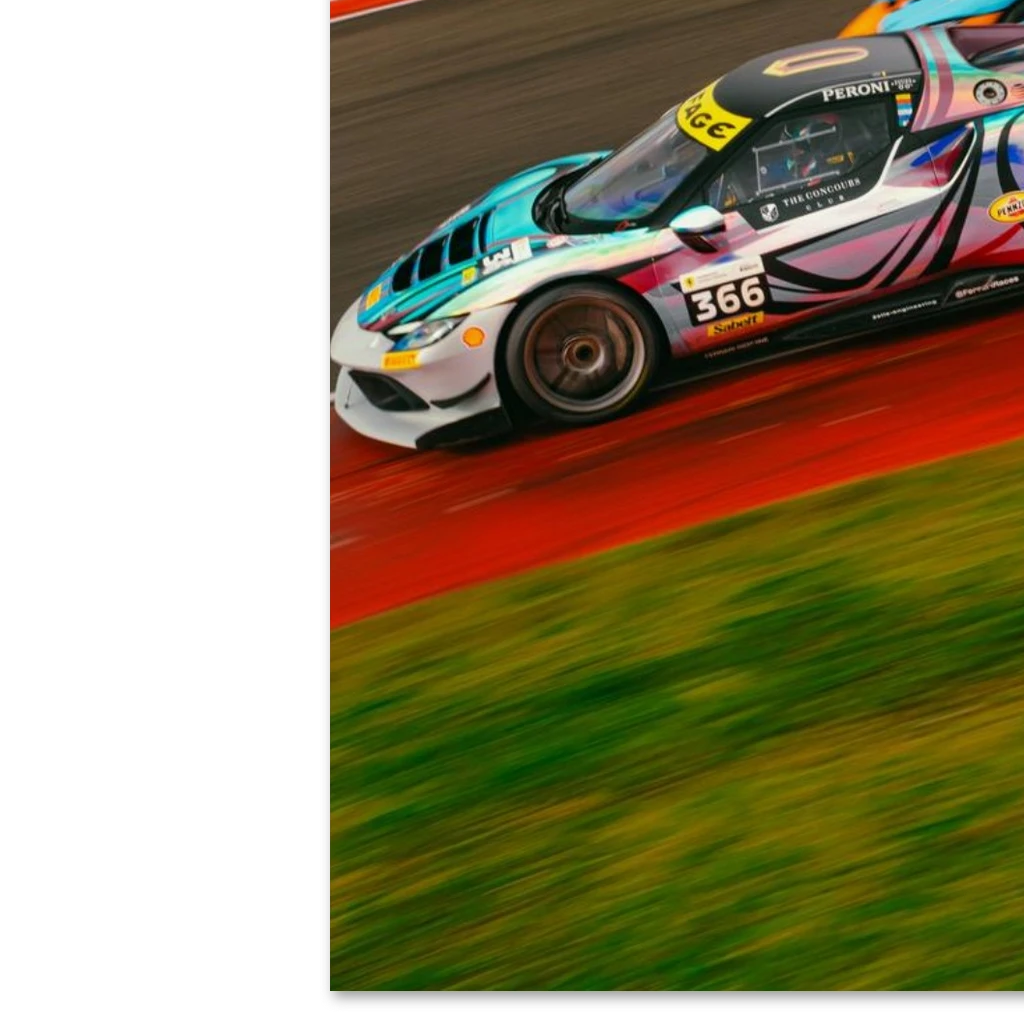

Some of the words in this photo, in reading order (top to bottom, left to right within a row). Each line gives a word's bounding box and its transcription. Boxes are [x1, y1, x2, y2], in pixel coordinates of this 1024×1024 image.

[821, 80, 891, 103] PERONI
[782, 195, 805, 208] THE
[691, 276, 765, 323] 366
